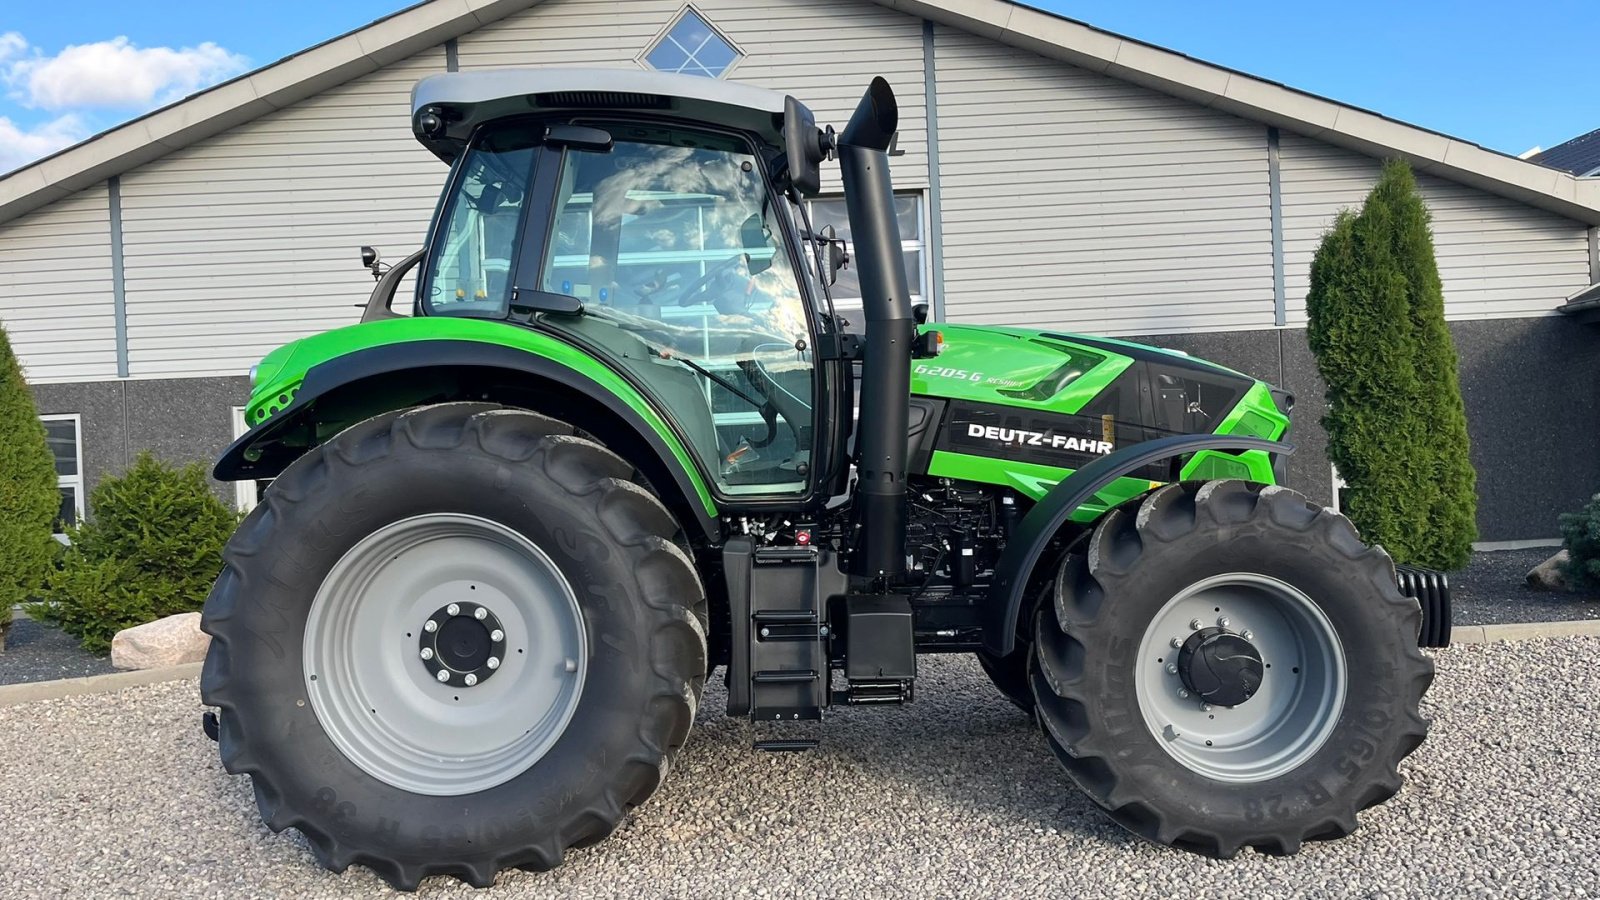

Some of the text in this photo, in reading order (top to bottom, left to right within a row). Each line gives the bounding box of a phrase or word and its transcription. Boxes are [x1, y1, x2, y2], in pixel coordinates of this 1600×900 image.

[914, 364, 969, 380] 6205
[969, 372, 984, 382] G
[967, 423, 1114, 455] DEUTZ-FAHR
[1244, 793, 1291, 824] 28
